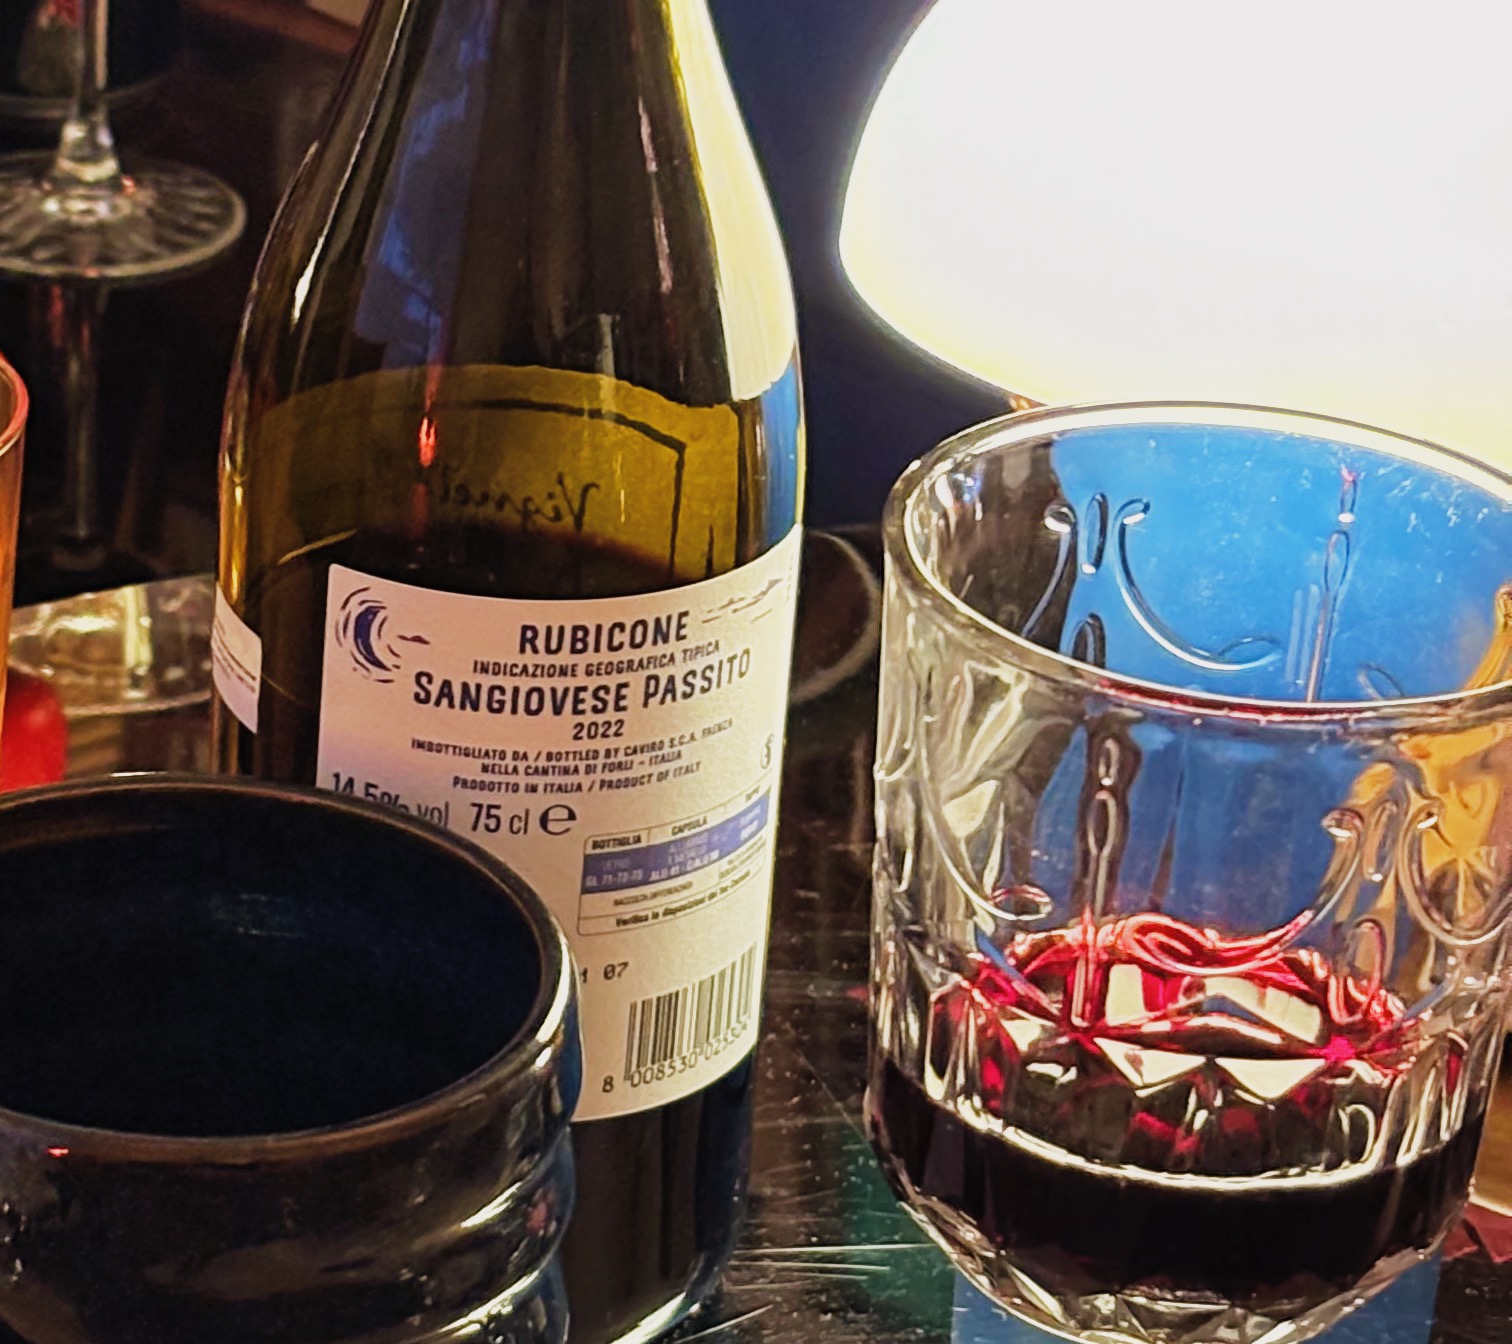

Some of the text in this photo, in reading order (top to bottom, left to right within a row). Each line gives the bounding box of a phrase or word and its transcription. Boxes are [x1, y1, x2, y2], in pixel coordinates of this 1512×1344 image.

[519, 610, 690, 655] RUBICONE
[472, 640, 720, 679] INDICAZIONE GEOGRAFICA TIPICA
[413, 647, 751, 717] SANGIOVESE PASSITO
[572, 718, 626, 741] 2022
[411, 737, 507, 762] IMBOTTIGLIATO
[511, 750, 529, 762] DA
[545, 748, 600, 762] BOTTLED
[604, 747, 621, 760] BY
[624, 739, 665, 757] CAVIRO
[481, 762, 520, 777] NELLA
[524, 763, 580, 777] CANTINA
[584, 763, 597, 775] DI
[648, 749, 683, 766] ITALIA
[452, 775, 520, 794] PRODOTTO
[524, 782, 538, 794] IN
[543, 781, 583, 794] ITALIA
[598, 772, 655, 792] PRODUCT
[656, 768, 670, 783] OF
[672, 760, 702, 778] ITALY
[469, 801, 502, 834] 75
[508, 808, 530, 836] cl
[591, 833, 643, 851] BOTTIGLIA
[601, 1075, 615, 1094] 8
[630, 1052, 699, 1088] 008530
